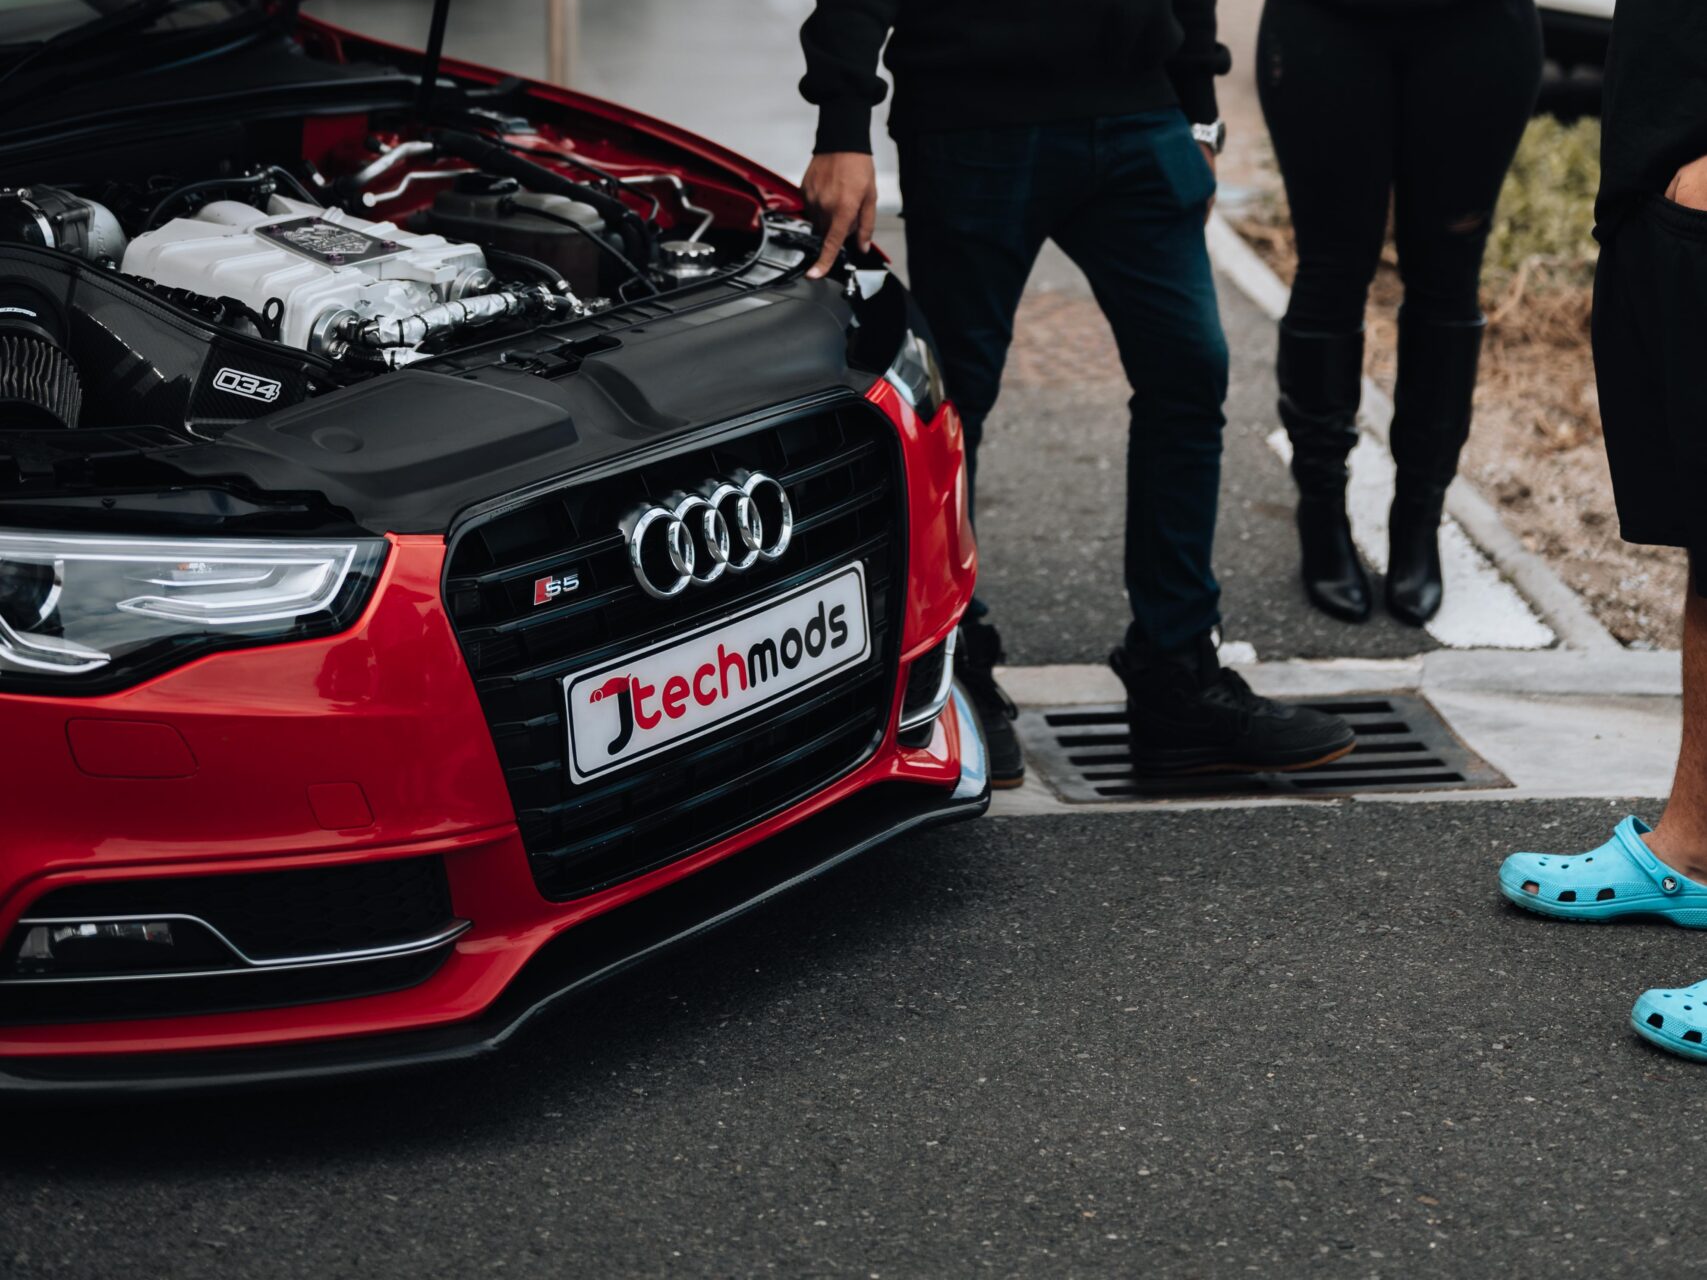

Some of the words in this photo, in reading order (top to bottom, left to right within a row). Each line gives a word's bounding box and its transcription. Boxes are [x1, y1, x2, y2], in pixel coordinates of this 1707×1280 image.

[216, 371, 277, 399] 034
[545, 574, 579, 597] S5
[589, 600, 848, 755] Jtechmods
